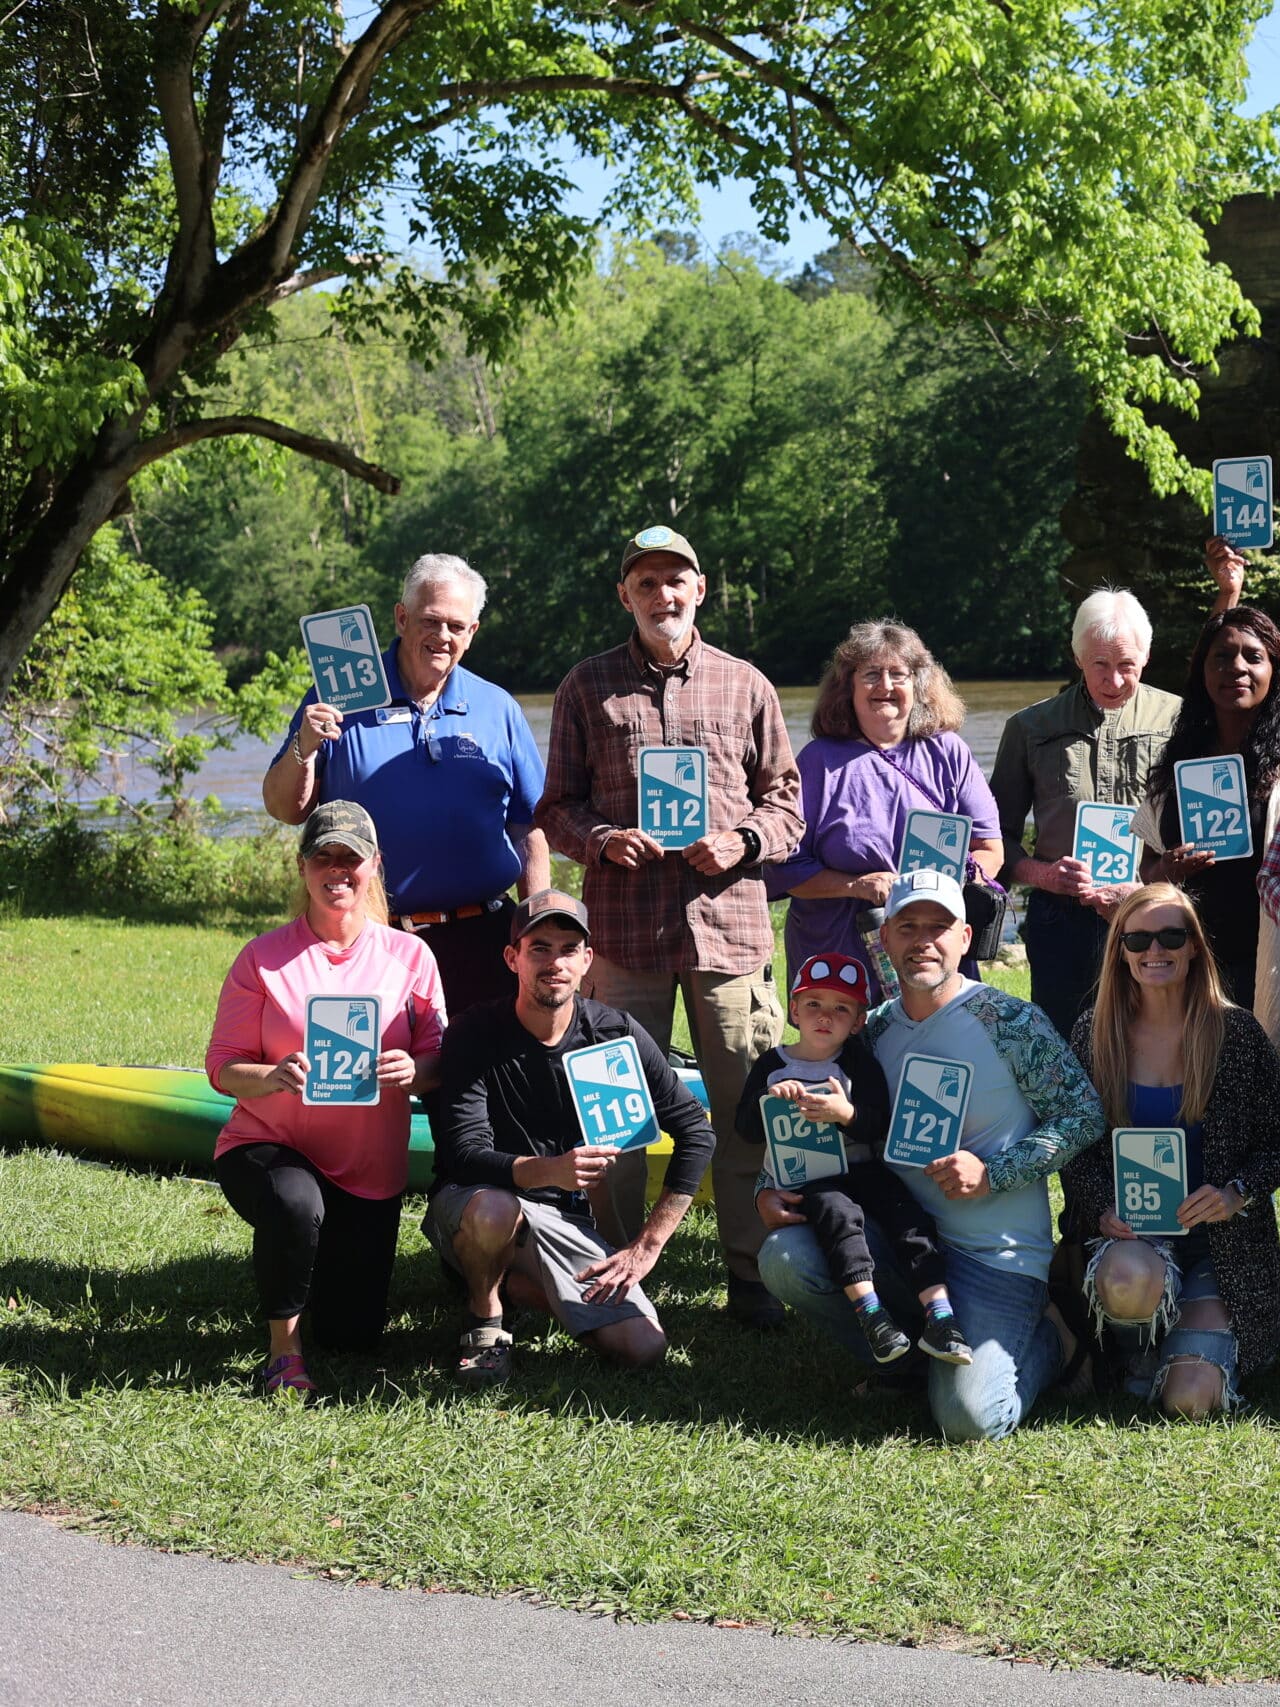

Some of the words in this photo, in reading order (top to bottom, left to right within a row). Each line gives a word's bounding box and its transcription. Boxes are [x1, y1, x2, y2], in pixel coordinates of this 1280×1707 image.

[1222, 503, 1266, 530] 144
[318, 655, 334, 664] MILE
[322, 658, 377, 693] 113
[327, 691, 363, 702] Tallapoosa
[1187, 801, 1203, 810] MILE
[648, 799, 700, 826] 112
[1189, 808, 1243, 839] 122
[648, 829, 682, 837] Tallapoosa
[1081, 840, 1097, 848] MILE
[1195, 840, 1227, 848] allapoosa
[909, 848, 925, 857] MILE
[1081, 850, 1129, 879] 123
[315, 1050, 371, 1080] 124
[313, 1082, 352, 1090] Tallapoosa
[583, 1092, 600, 1103] MILE
[904, 1098, 920, 1108] MILE
[588, 1093, 646, 1133] 119
[902, 1110, 951, 1146] 121
[594, 1129, 632, 1144] Tallapoosa
[816, 1135, 833, 1144] MILE
[895, 1140, 931, 1153] Tallapoosa
[893, 1149, 911, 1158] River
[1124, 1182, 1161, 1211] 85
